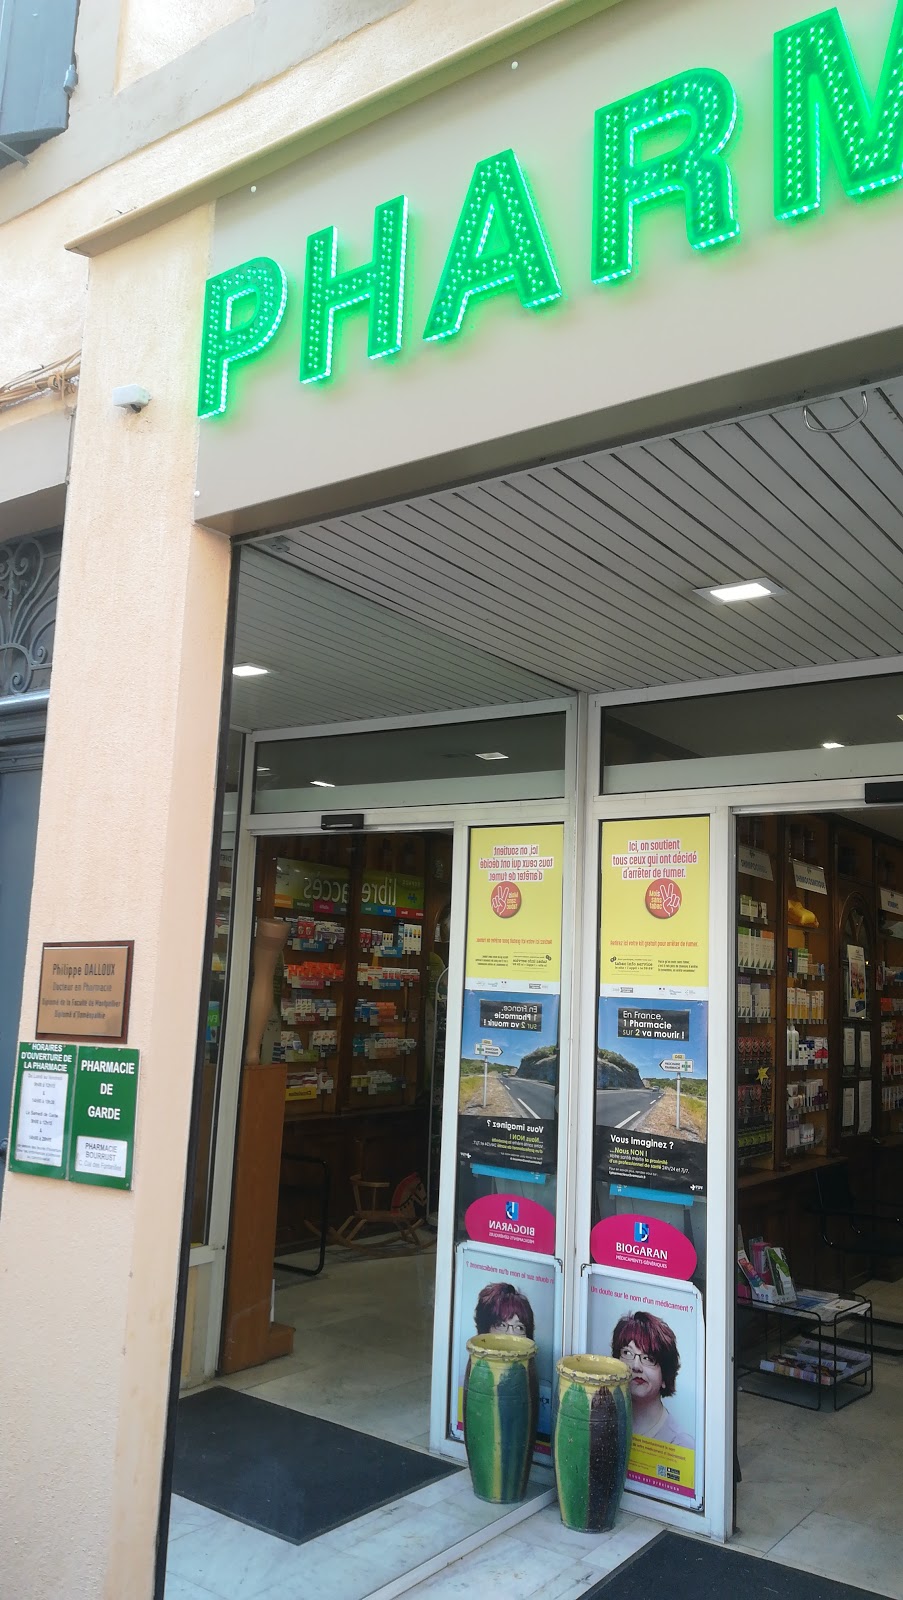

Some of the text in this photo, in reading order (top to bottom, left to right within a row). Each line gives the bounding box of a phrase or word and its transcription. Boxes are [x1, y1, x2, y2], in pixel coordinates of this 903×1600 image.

[628, 839, 680, 853] Ici, on soutient
[613, 851, 697, 867] tous ceux qui ont décidé
[622, 866, 686, 879] d'arrêter de fumer.
[53, 963, 116, 979] Philippe DALLOUX
[53, 982, 74, 992] Docteur
[83, 982, 113, 993] Pharmacie
[623, 1010, 664, 1020] En France,
[623, 1019, 672, 1031] 1 Pharmacie
[653, 1030, 680, 1039] mourir
[681, 1031, 685, 1039] !
[32, 1043, 63, 1053] HORAIRES
[21, 1052, 73, 1063] D'OUVERTURE DE
[24, 1061, 68, 1072] LA PHARMACIE
[81, 1060, 135, 1075] PHARMACIE
[100, 1082, 114, 1096] DE
[88, 1105, 122, 1121] GARDE
[85, 1142, 118, 1153] PHARMACIE
[610, 1134, 675, 1150] Vous imaginez ?
[85, 1151, 117, 1162] BOURRUST
[630, 1148, 645, 1157] NON
[616, 1242, 668, 1260] BIOGARAN
[598, 1287, 613, 1297] doute
[614, 1291, 622, 1299] sur
[623, 1292, 629, 1300] le
[630, 1295, 642, 1303] nom
[642, 1295, 655, 1305] d'un
[655, 1299, 689, 1312] médicament
